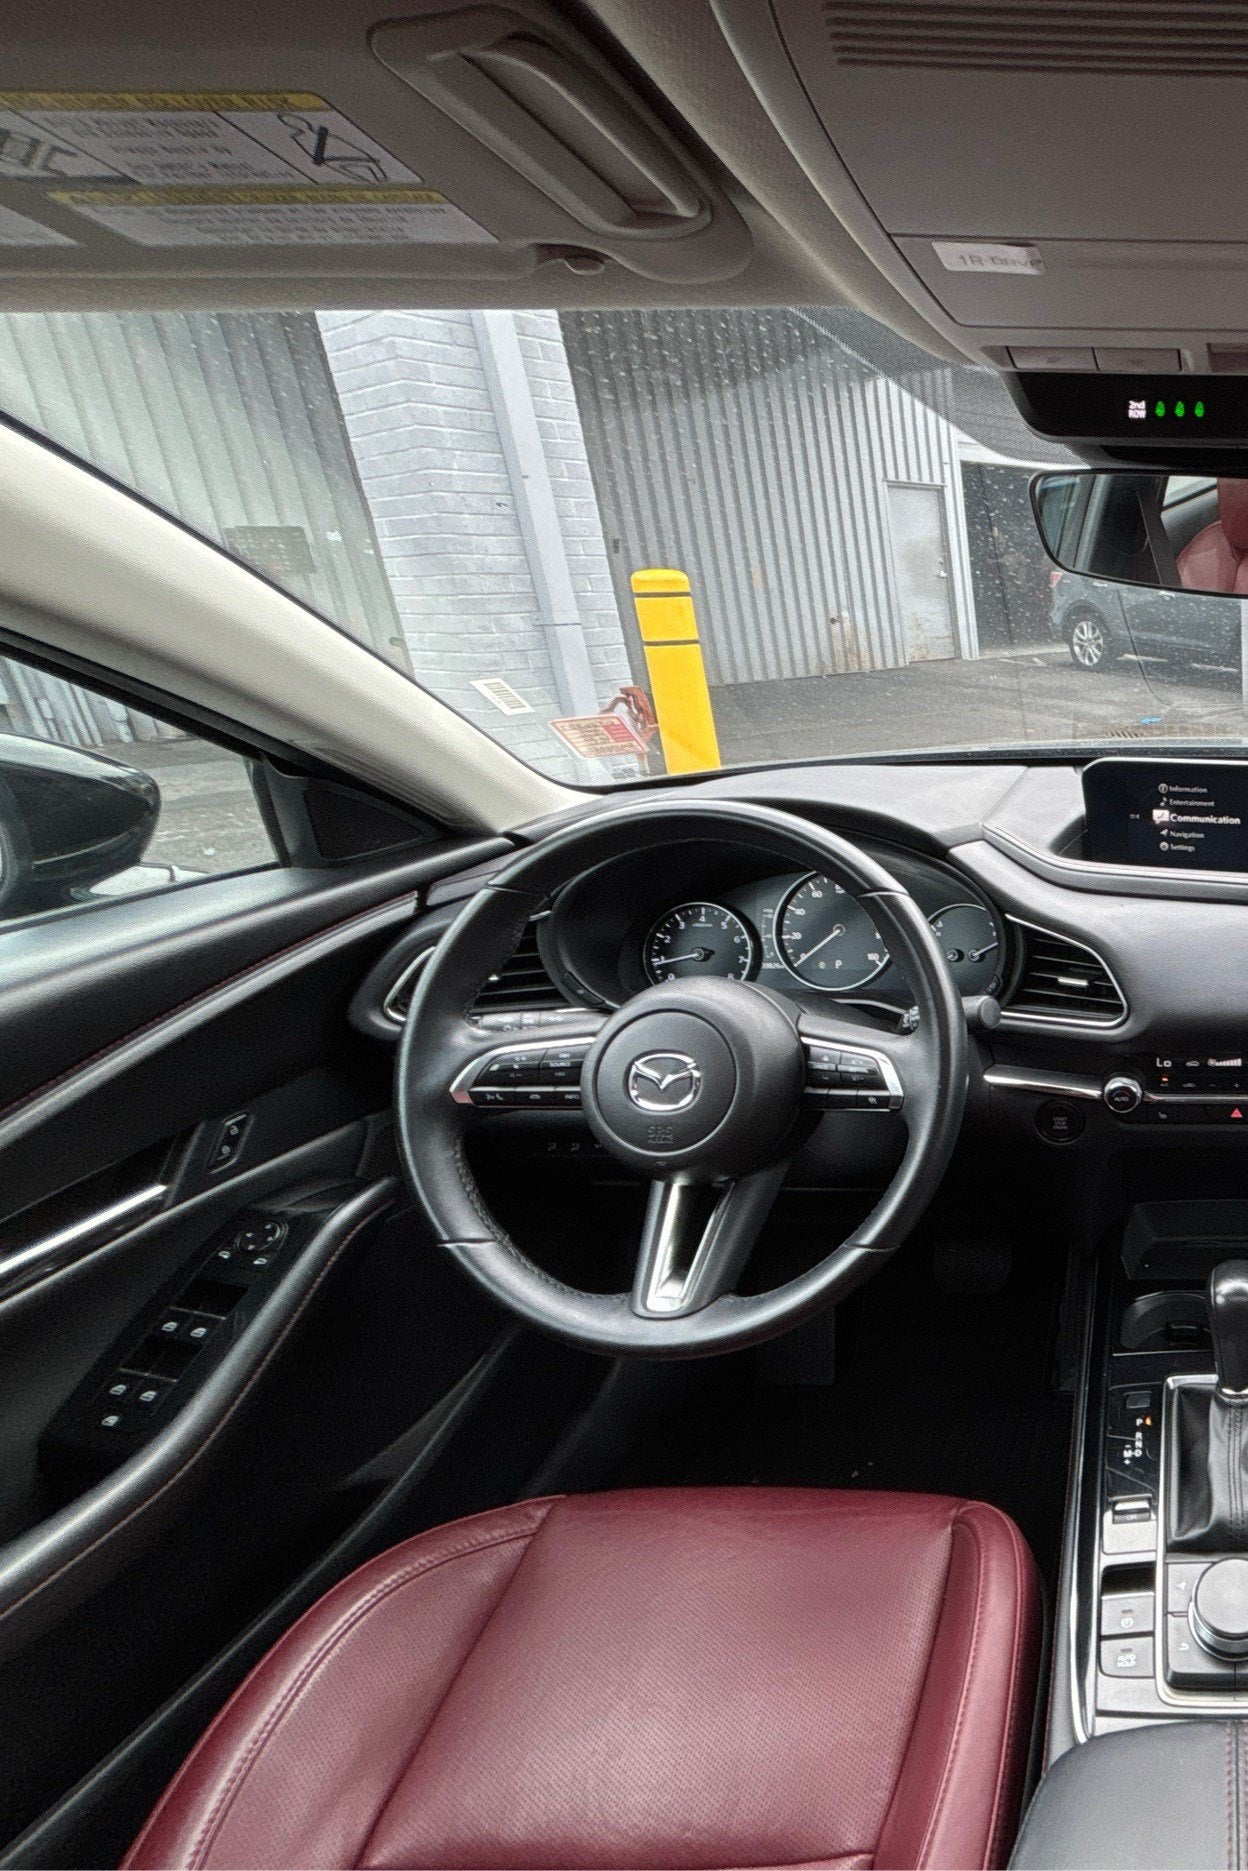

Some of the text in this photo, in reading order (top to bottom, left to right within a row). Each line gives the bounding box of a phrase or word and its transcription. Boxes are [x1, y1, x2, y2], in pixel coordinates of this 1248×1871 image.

[1128, 400, 1146, 409] 2nd
[1128, 409, 1147, 419] ROW
[1169, 786, 1208, 795] Information
[1169, 798, 1216, 808] Entertainment
[1169, 813, 1242, 826] Communication
[1170, 830, 1205, 840] Navigation
[1170, 842, 1196, 853] Settings
[835, 959, 843, 969] P
[1156, 1057, 1172, 1068] Lo
